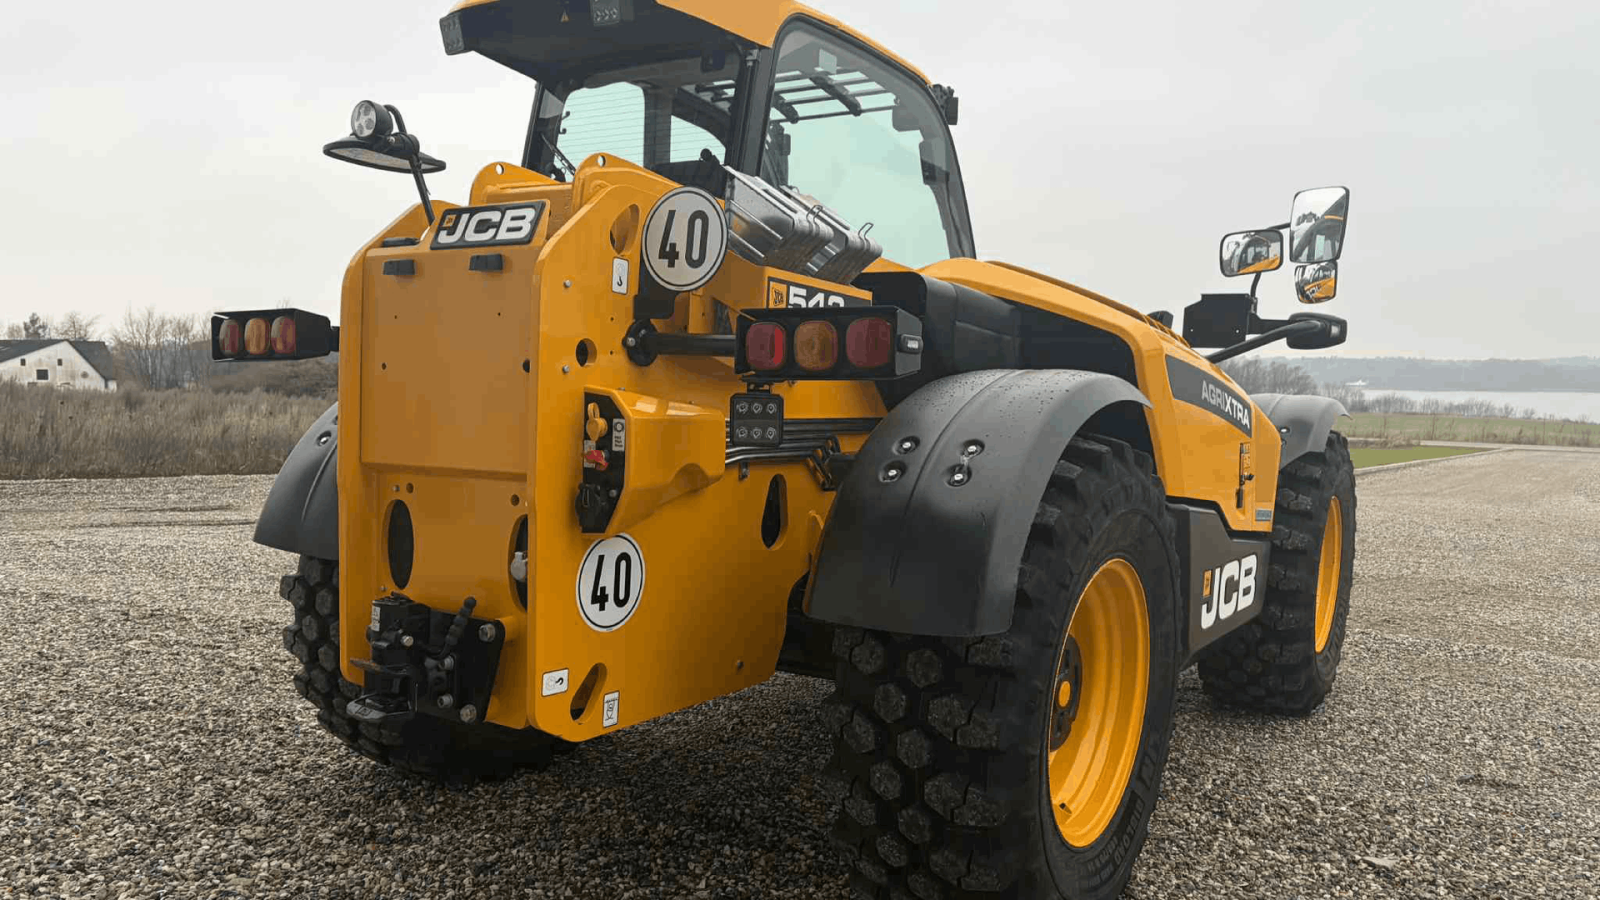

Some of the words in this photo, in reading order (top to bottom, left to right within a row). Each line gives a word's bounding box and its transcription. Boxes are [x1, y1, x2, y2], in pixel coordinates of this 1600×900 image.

[437, 207, 536, 244] JCB
[658, 208, 710, 268] 40
[1201, 380, 1250, 430] AGRIXTRA
[590, 552, 632, 612] 40
[1201, 554, 1257, 630] JCB
